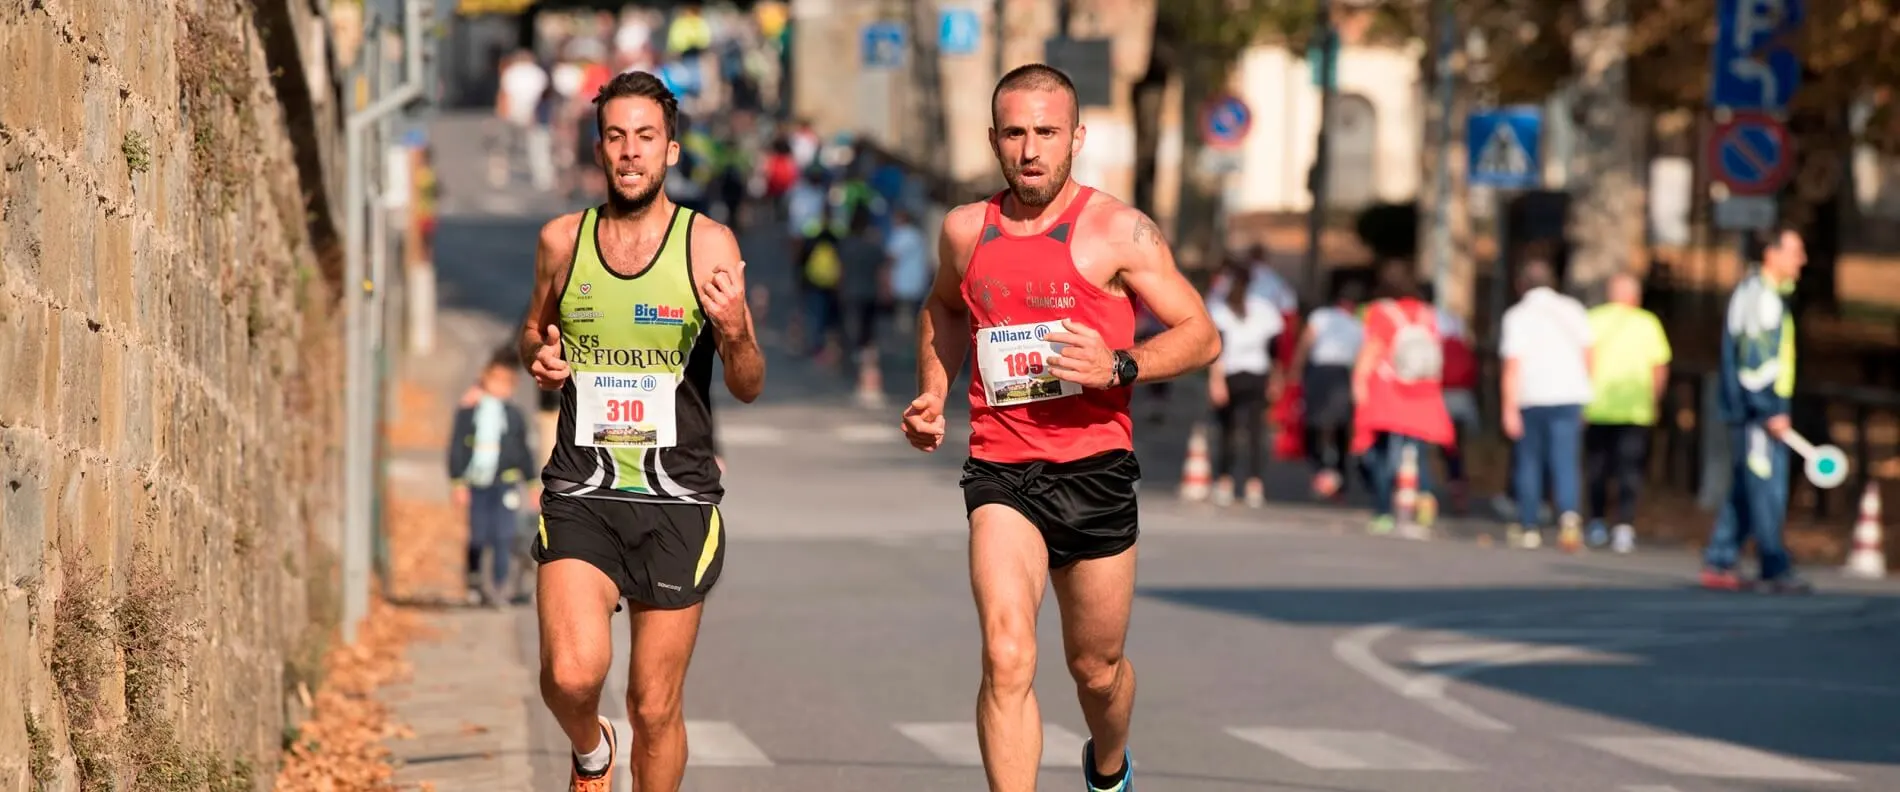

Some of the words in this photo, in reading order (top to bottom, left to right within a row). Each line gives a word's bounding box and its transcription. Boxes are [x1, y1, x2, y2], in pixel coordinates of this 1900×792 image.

[1026, 296, 1075, 308] CHIANCIANO
[635, 303, 684, 321] BigMat
[579, 334, 600, 354] gs
[990, 329, 1032, 343] Allianz
[594, 349, 684, 368] FIORINO
[1003, 351, 1044, 377] 189
[594, 376, 638, 389] Allianz
[607, 399, 644, 422] 310
